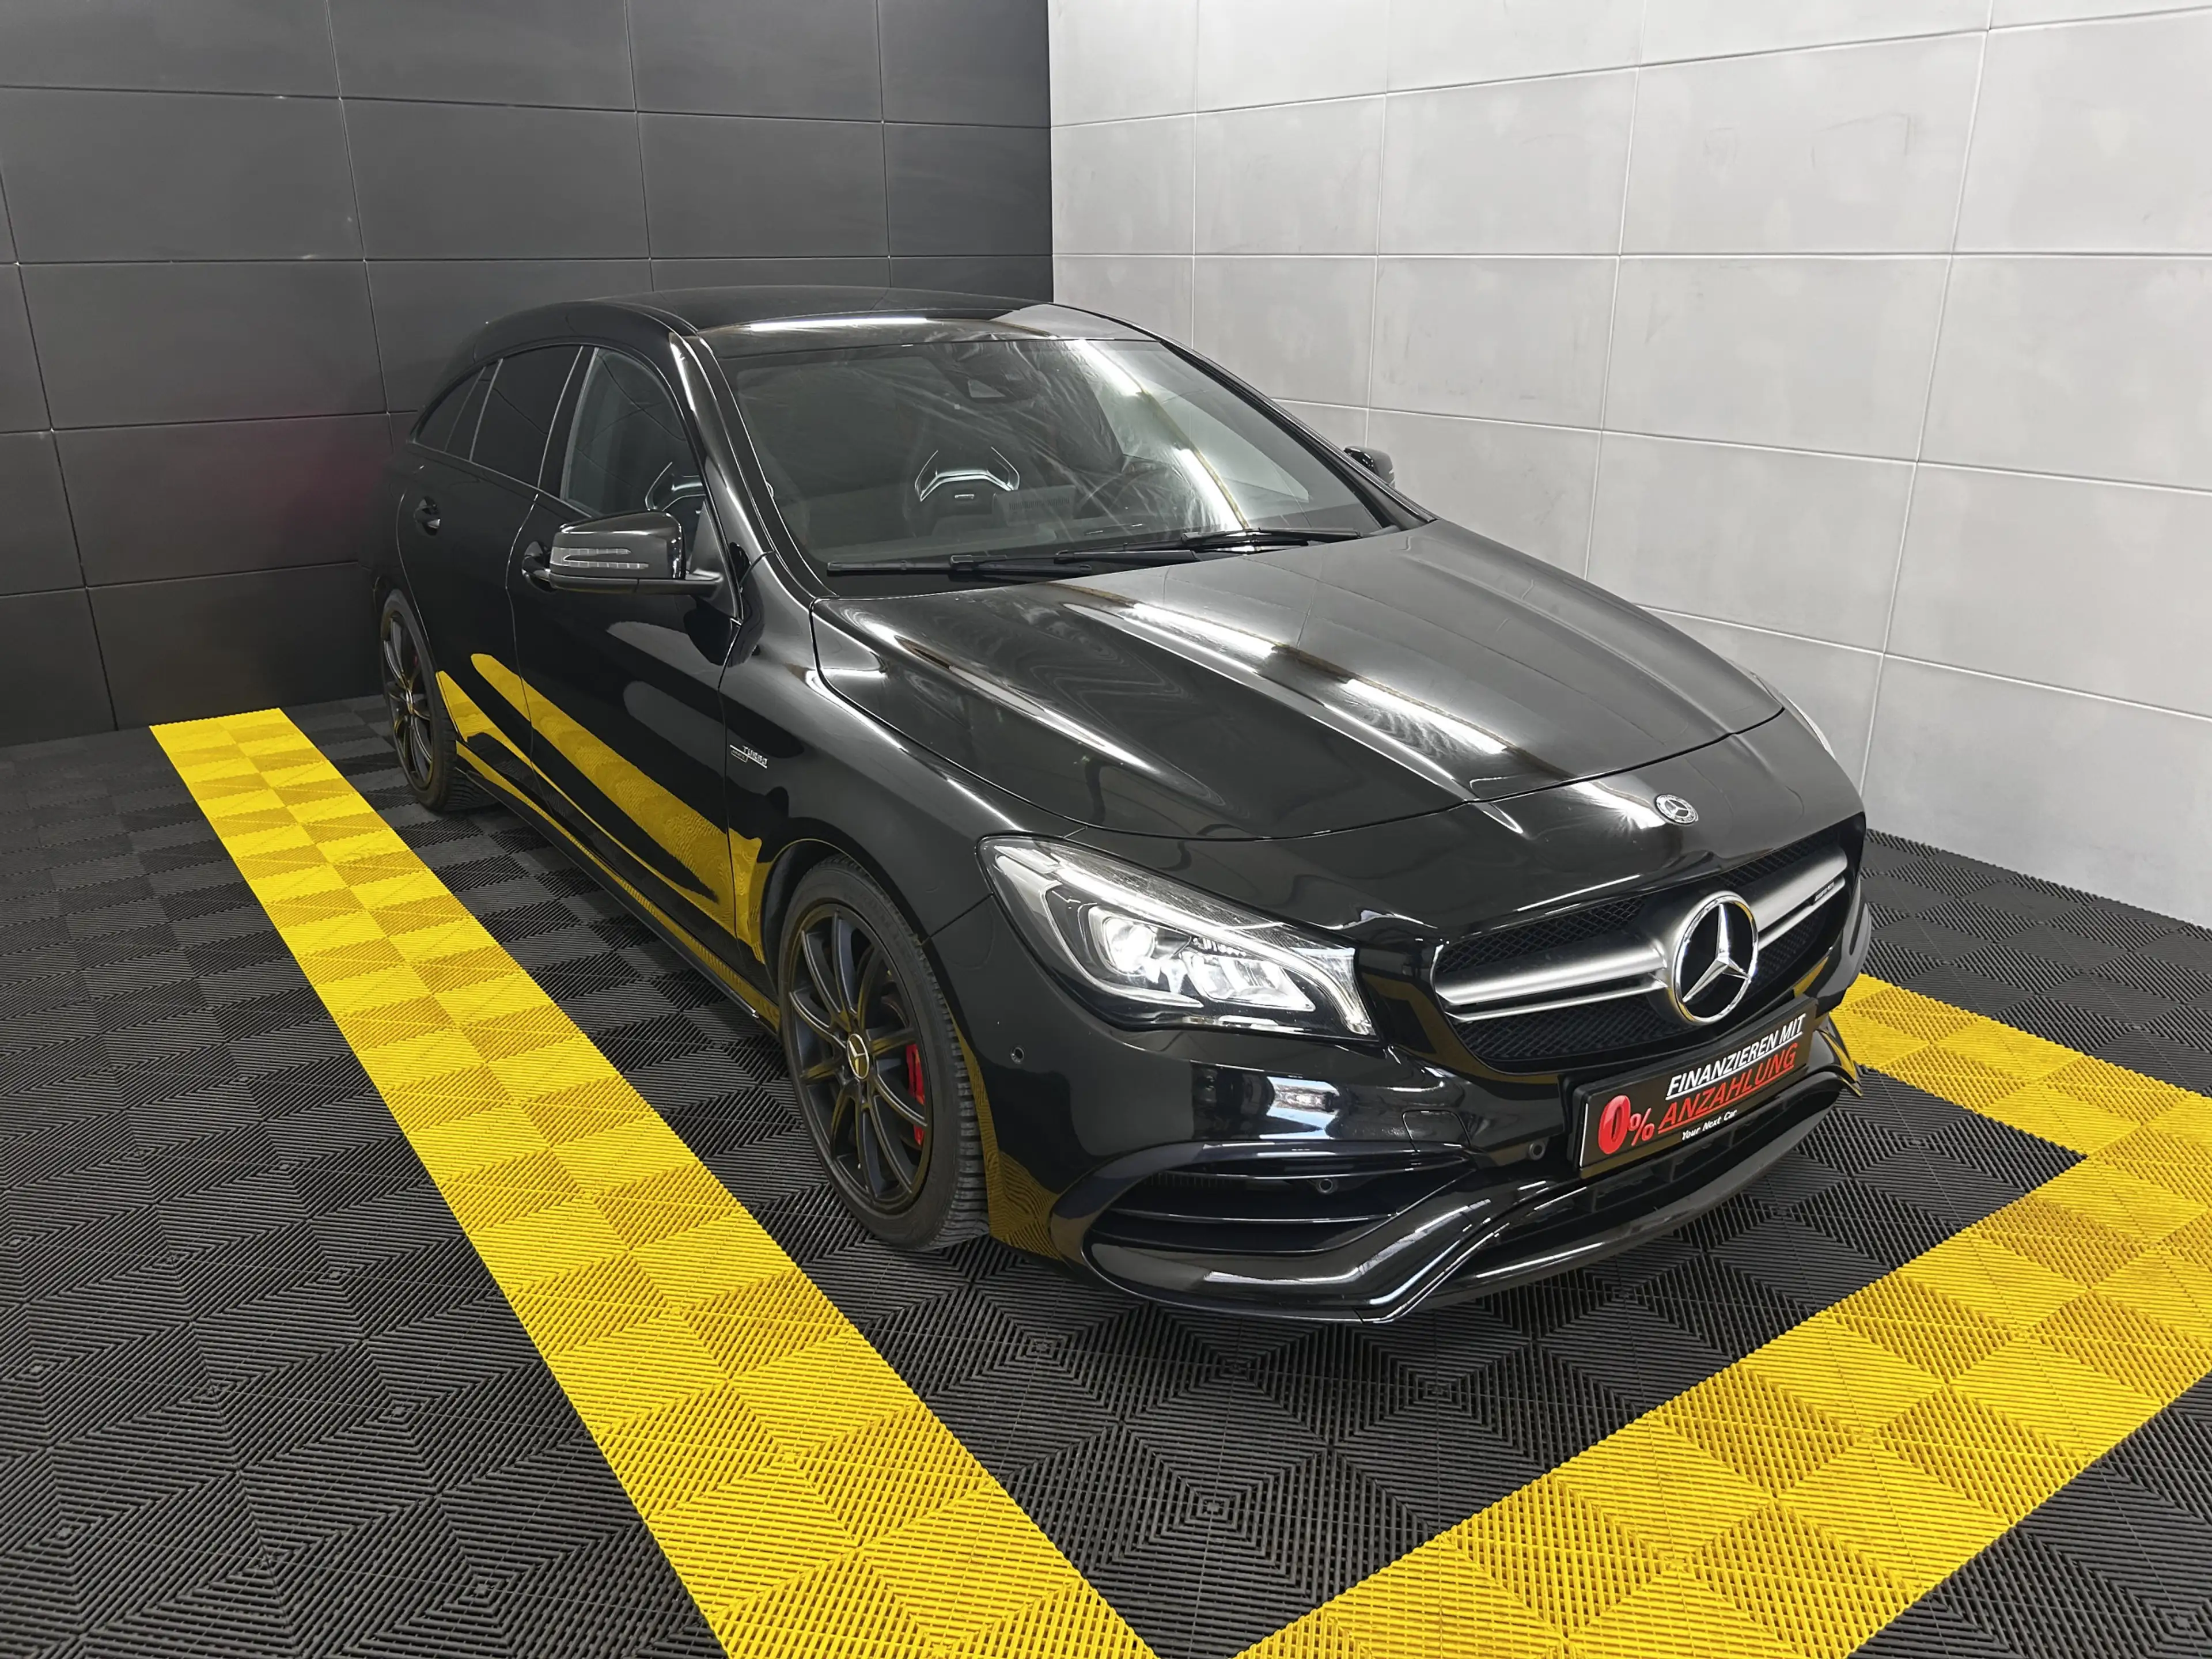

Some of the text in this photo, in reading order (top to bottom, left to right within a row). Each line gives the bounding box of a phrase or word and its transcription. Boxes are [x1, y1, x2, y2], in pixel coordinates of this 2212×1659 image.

[742, 745, 767, 765] TURBO
[1667, 1013, 1806, 1097] FINANZIEREN MIT
[1598, 1043, 1798, 1154] 0% ANZAHLUNG
[1681, 1109, 1737, 1140] Your Next Car
